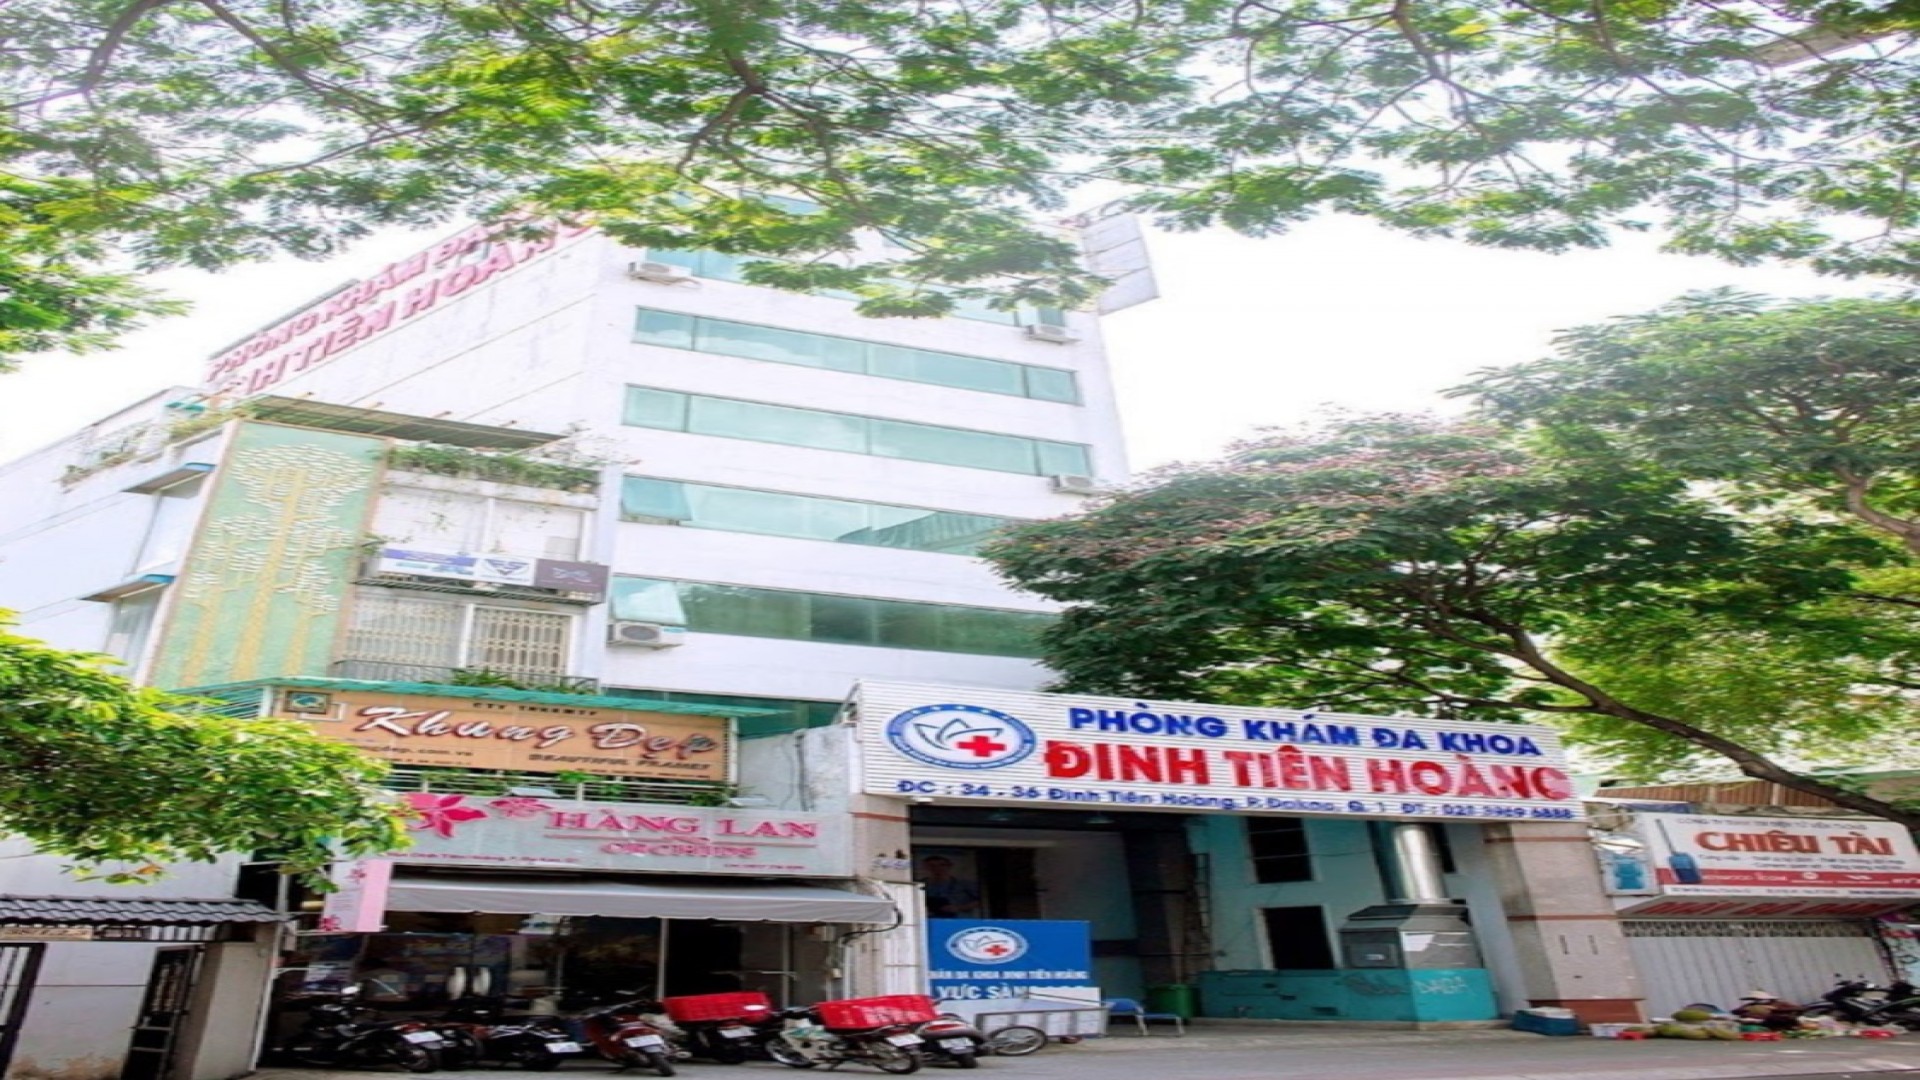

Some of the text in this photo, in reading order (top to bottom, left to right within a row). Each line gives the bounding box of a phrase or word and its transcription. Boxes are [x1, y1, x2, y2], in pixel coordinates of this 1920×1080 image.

[354, 705, 717, 760] Khung Đẹp
[1069, 702, 1543, 756] PHÒNG KHÁM ĐA KHOA
[1043, 740, 1209, 785] ĐINH
[1223, 745, 1352, 791] TIÊN
[897, 780, 936, 793] ĐC
[962, 783, 989, 796] 34
[1011, 786, 1040, 798] 36
[1048, 788, 1100, 802] Đinh
[1107, 790, 1154, 804] Tiên
[551, 808, 818, 839] HÀNG LAN
[1694, 829, 1896, 856] CHIÊU TÀI
